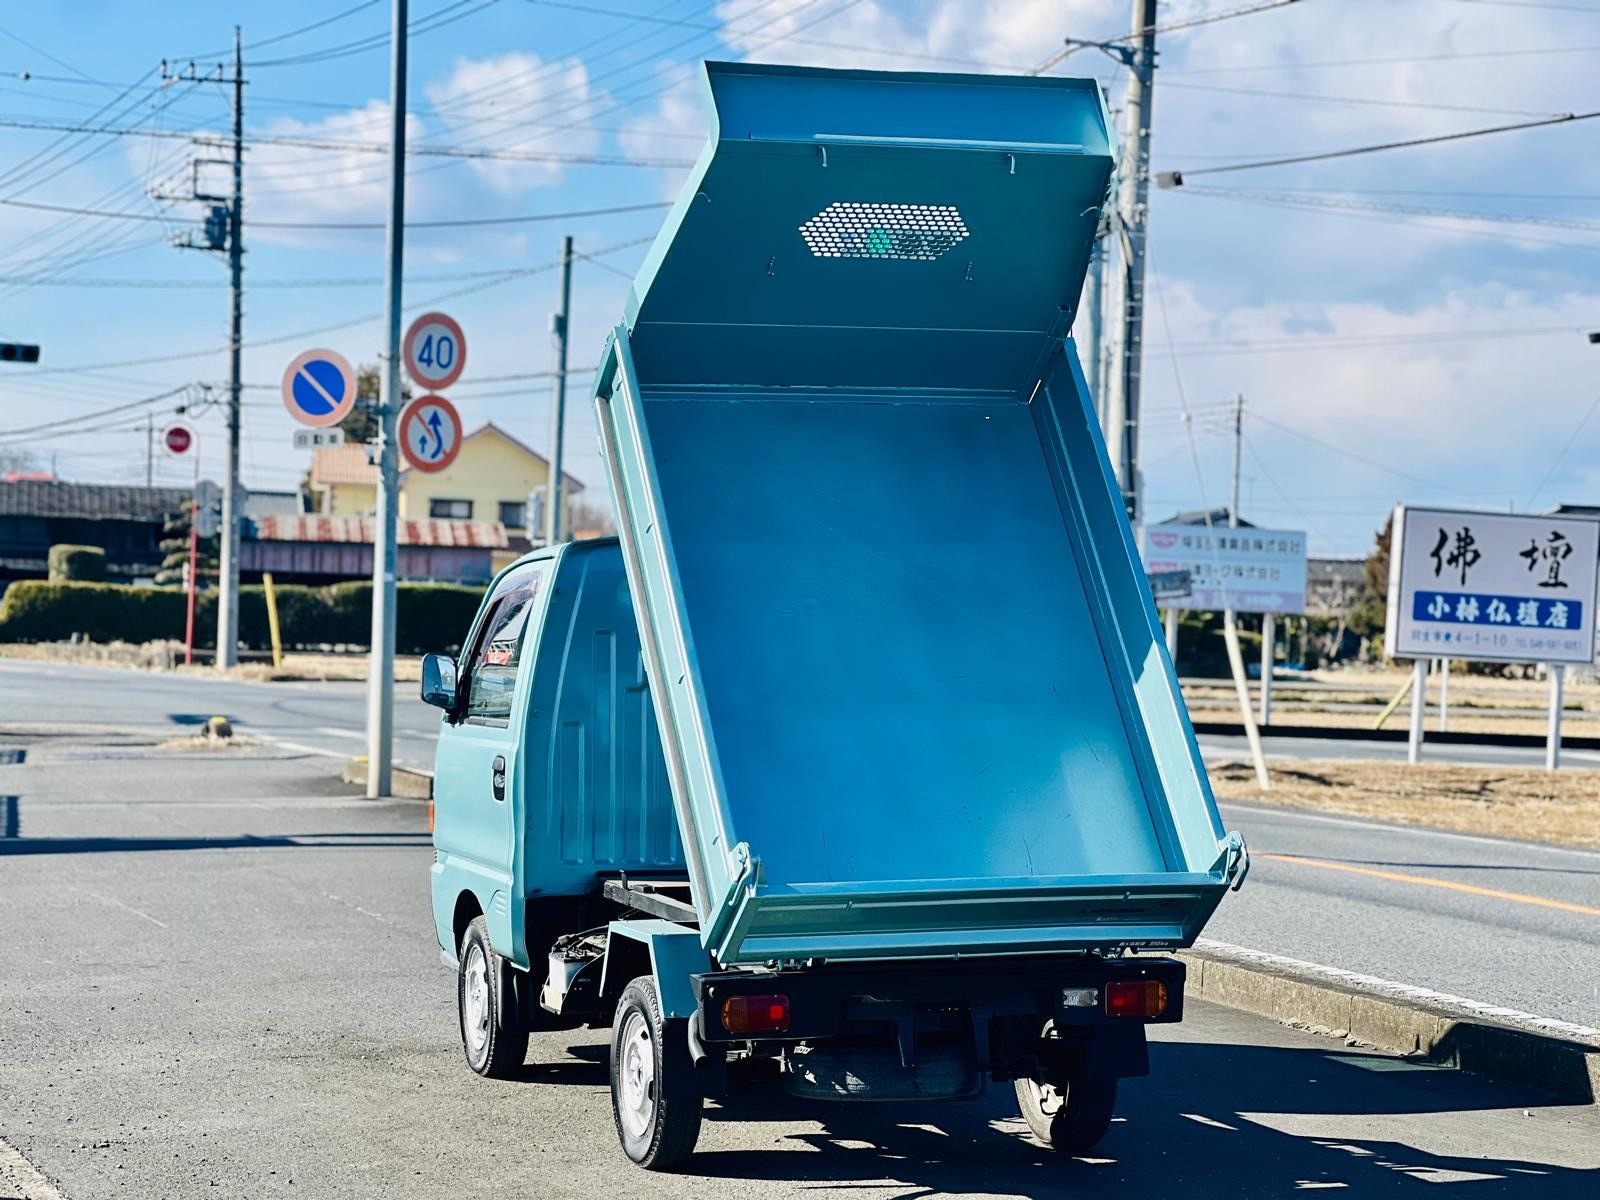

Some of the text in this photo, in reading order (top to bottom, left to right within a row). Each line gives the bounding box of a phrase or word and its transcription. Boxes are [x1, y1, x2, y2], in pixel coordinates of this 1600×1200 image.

[418, 334, 454, 369] 40
[1427, 594, 1569, 629] 小林仏壇店
